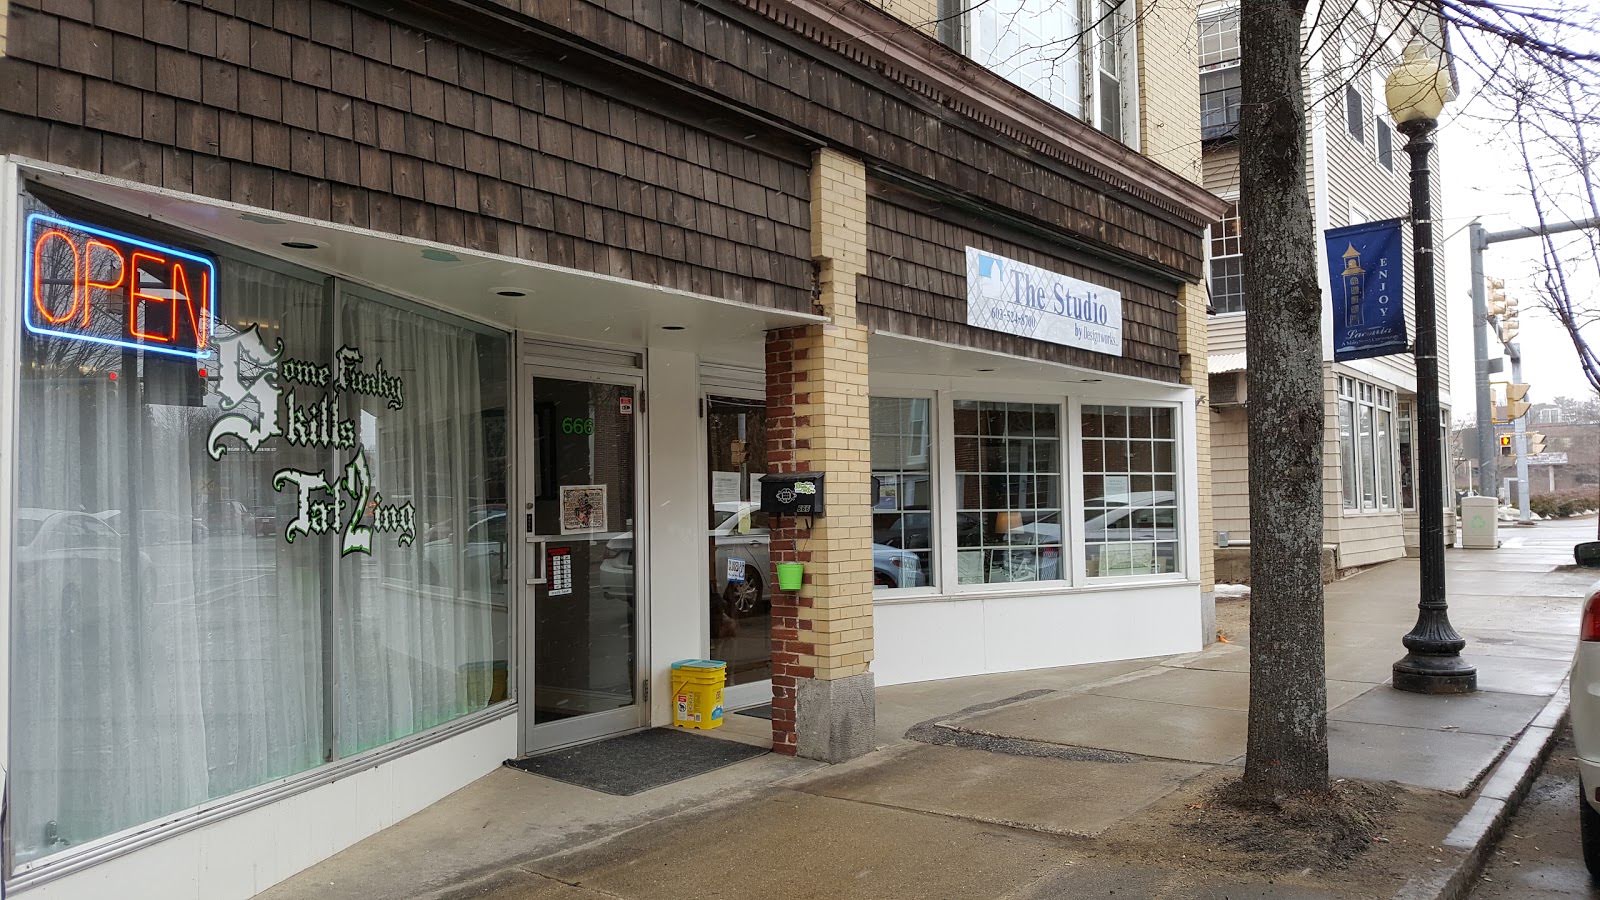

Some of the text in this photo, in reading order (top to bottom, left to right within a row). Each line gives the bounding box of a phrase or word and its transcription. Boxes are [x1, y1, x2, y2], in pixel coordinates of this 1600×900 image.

[33, 230, 208, 348] OPEN
[1010, 269, 1108, 326] The Studio
[1378, 257, 1389, 317] ENJOY
[1074, 322, 1082, 340] by
[333, 344, 403, 410] Funky
[562, 417, 594, 435] 666
